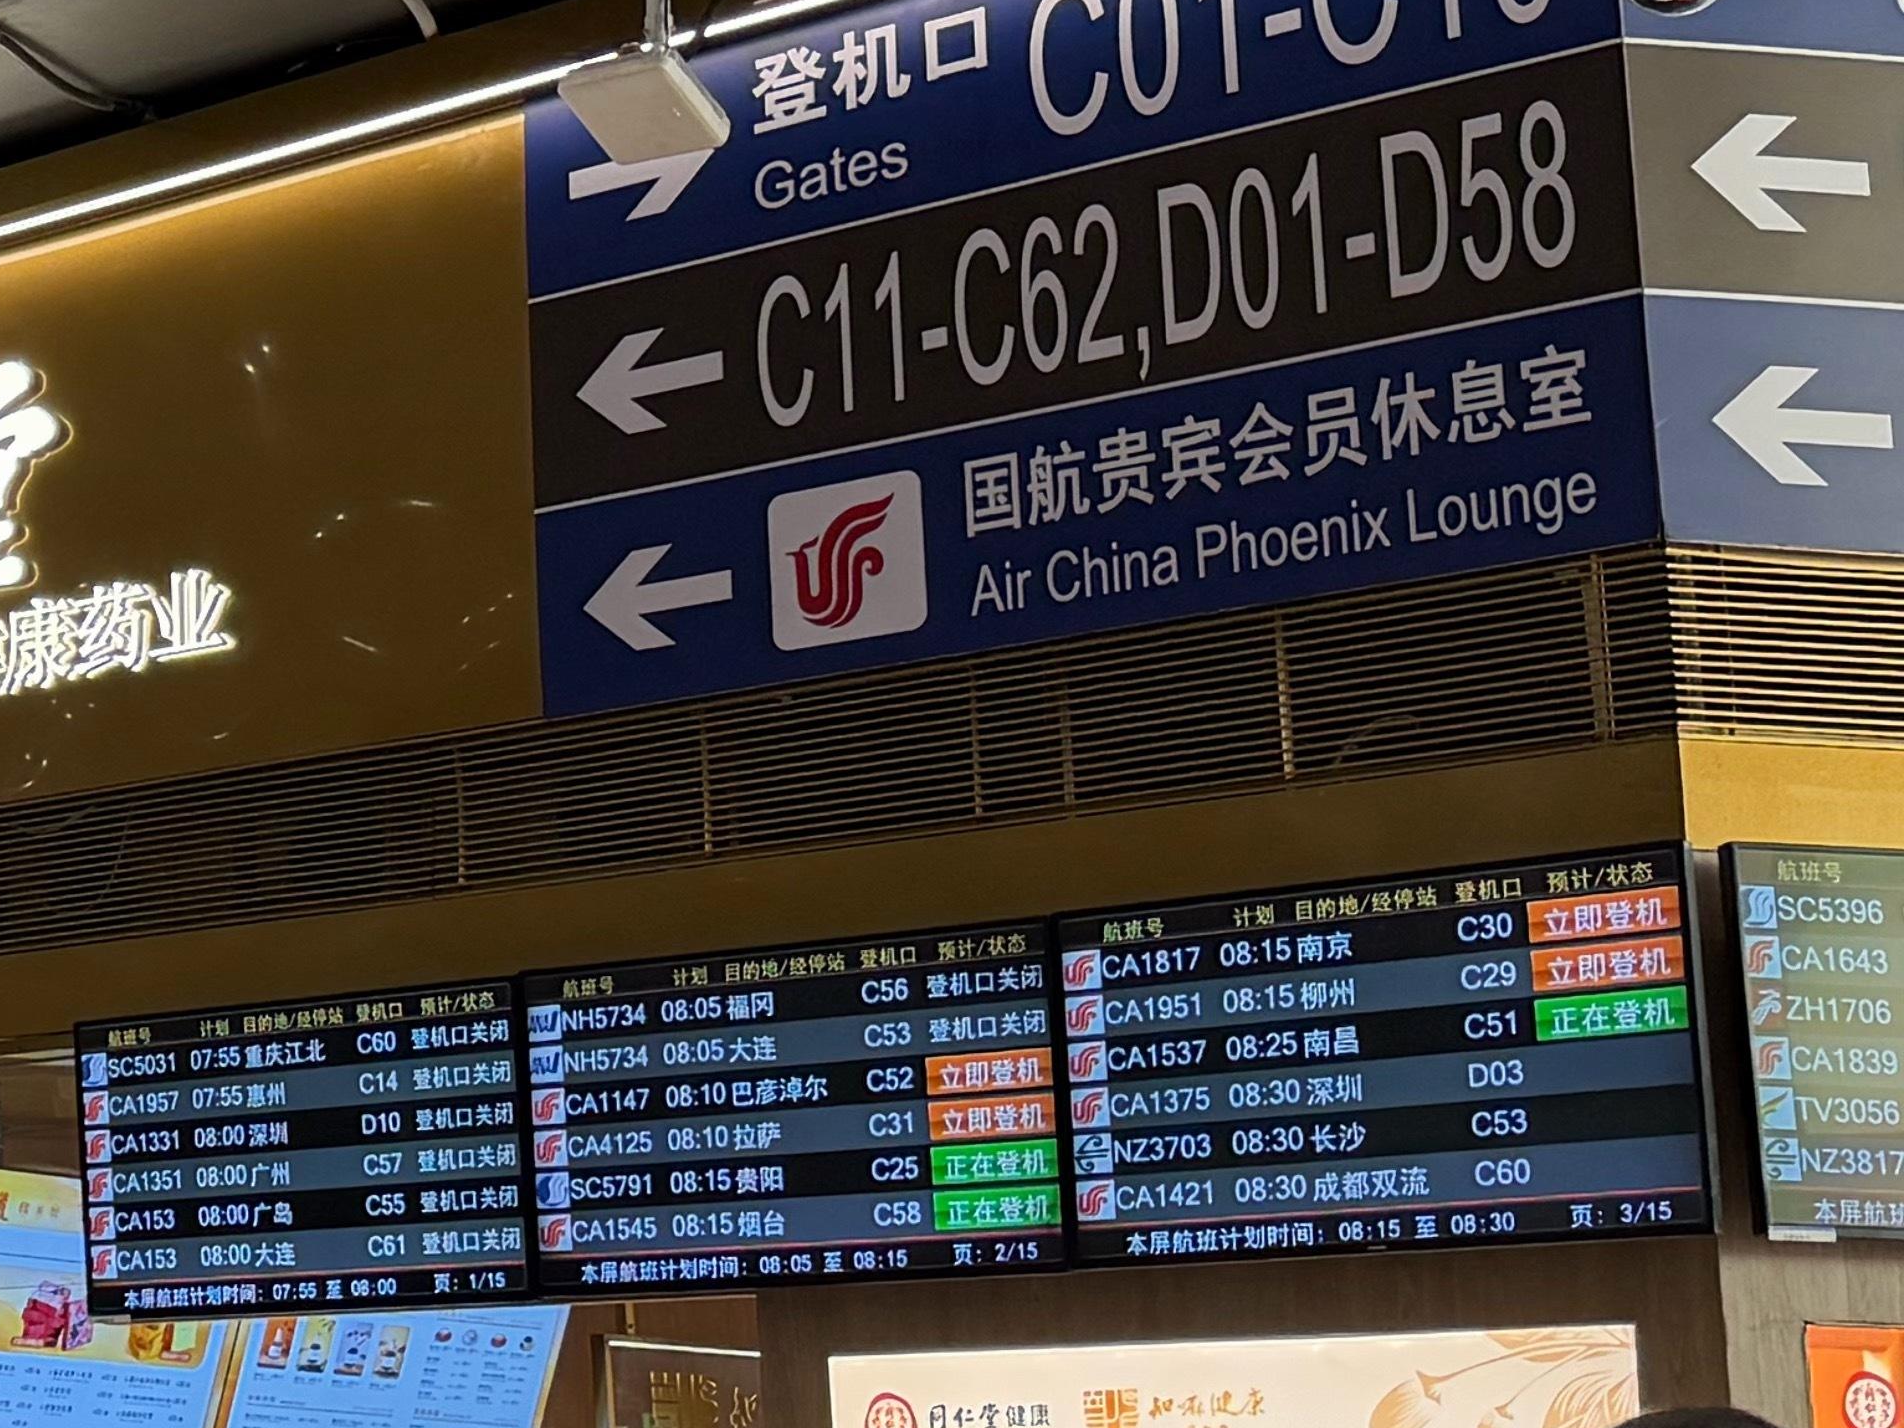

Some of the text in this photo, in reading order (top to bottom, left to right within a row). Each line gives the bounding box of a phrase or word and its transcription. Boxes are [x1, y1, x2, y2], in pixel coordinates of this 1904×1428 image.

[751, 4, 991, 136] 登机口
[753, 136, 911, 211] Gates
[757, 98, 1577, 431] C11-C62,D01-D58
[964, 346, 1593, 539] 国航贵宾会员休息室
[971, 464, 1597, 618] Air China Phoenix Lounge
[1777, 860, 1842, 883] 航班号
[1103, 917, 1163, 944] 航班号
[1233, 903, 1275, 929] 计划
[1455, 877, 1523, 904] 登机口
[1778, 896, 1884, 924] SC5396
[1102, 899, 1666, 978] CA1817 08:15 南京 C30 立即登机
[1782, 946, 1888, 974] CA1643
[562, 965, 1043, 1030] NH5734 08:05 福冈 C56 登机口关闭
[1105, 948, 1671, 1024] CA1951 08:15 柳州 C29 立即登机
[1786, 996, 1891, 1025] ZH1706
[109, 1031, 396, 1078] SC5031 07:55 重庆江北 C60
[564, 1010, 1046, 1072] NH5734 08:05 大连 C53 登机口关闭
[1108, 998, 1675, 1070] CA1537 08:25 南昌 C51 正在登机
[1791, 1046, 1898, 1074] CA1839
[109, 1070, 398, 1115] CA1957 07:55 惠州 C14
[566, 1055, 1043, 1116] CA1147 08:10 巴彦淖尔 C52 立即登机
[1111, 1060, 1524, 1117] CA1375 08:30 深圳 D03
[1795, 1097, 1900, 1125] TV3056
[111, 1112, 400, 1153] CA1331 08:00 深圳 D10
[568, 1104, 1046, 1158] CA4125 08:10 拉萨 C31 立即登机
[1114, 1109, 1528, 1163] NZ3703 08:30 长沙 C53
[113, 1153, 402, 1192] CA1351 08:00 广州 C57
[571, 1149, 1047, 1200] SC5791 08:15 贵阳 C25 正在登机
[1116, 1158, 1530, 1211] CA1421 08:30 成都双流 C60
[1801, 1148, 1904, 1175] NZ3817
[115, 1194, 405, 1231] CA153 08:00 广岛 C55
[572, 1196, 1050, 1243] CA1545 08:15 烟台 C58 正在登机
[117, 1236, 405, 1270] CA153 08:00 大连 C61
